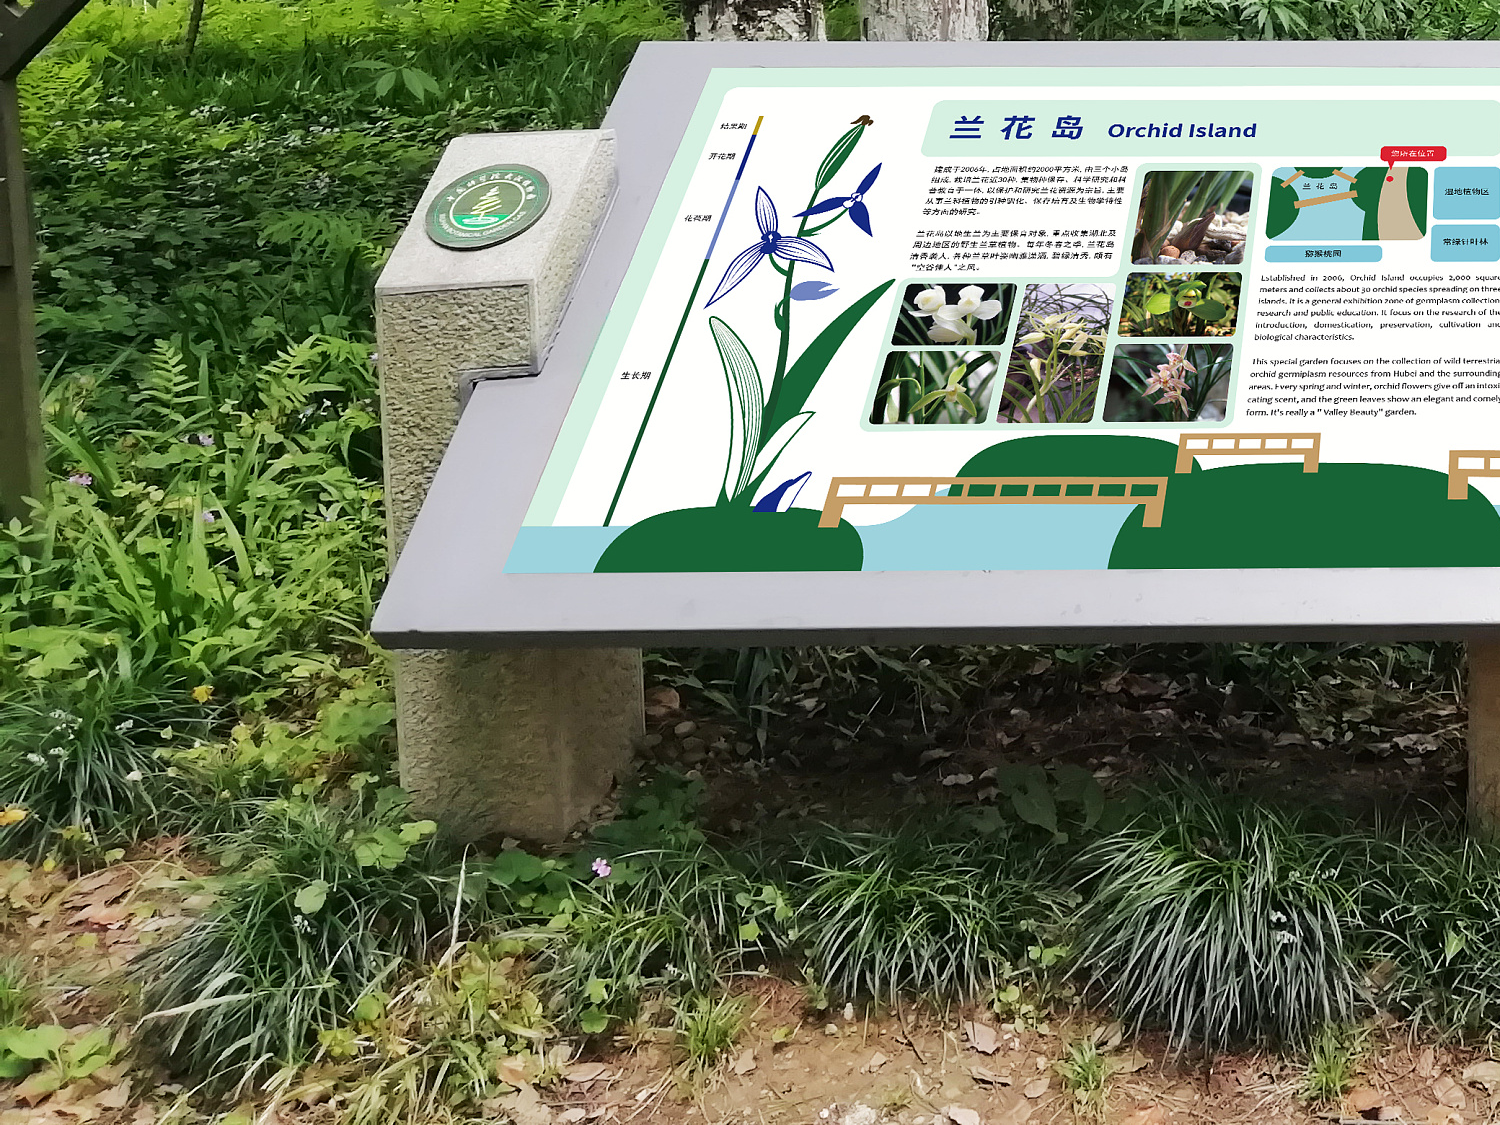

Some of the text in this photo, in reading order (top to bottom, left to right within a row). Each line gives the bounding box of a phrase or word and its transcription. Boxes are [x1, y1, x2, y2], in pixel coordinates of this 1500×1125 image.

[949, 114, 1084, 141] 兰花岛
[1107, 122, 1257, 138] Orchid Island
[708, 152, 737, 161] 开花期
[1390, 149, 1436, 158] 您所在位置
[1302, 181, 1338, 190] 兰花岛
[1444, 187, 1490, 196] 湿地植物区
[1442, 237, 1489, 246] 常绿针叶林
[1304, 249, 1342, 258] 猕猴桃园
[1260, 274, 1306, 282] Established
[1310, 274, 1318, 282] in
[1322, 274, 1345, 282] 2006,
[1349, 274, 1377, 282] Orchid
[1381, 273, 1405, 282] Island
[1409, 275, 1444, 283] occupies
[1448, 274, 1471, 282] 2,000
[1361, 287, 1371, 295] 30
[1372, 285, 1398, 293] orchid
[1398, 285, 1428, 294] species
[1428, 285, 1468, 294] spreading
[1258, 297, 1288, 305] islands.
[1311, 297, 1342, 307] general
[1415, 297, 1461, 306] germplasm
[1256, 309, 1292, 317] research
[1292, 309, 1309, 317] and
[1310, 308, 1335, 318] public
[1336, 308, 1379, 317] education.
[1389, 308, 1412, 316] focus
[1426, 308, 1440, 316] the
[1441, 308, 1477, 316] research
[1477, 308, 1488, 316] of
[1255, 321, 1308, 330] introduction,
[1313, 321, 1374, 330] domestication,
[1379, 321, 1433, 330] preservation,
[1438, 320, 1481, 329] cultivation
[1254, 333, 1355, 342] biological characteristics.
[1252, 357, 1268, 365] This
[1269, 357, 1298, 367] special
[1299, 357, 1329, 367] garden
[1330, 357, 1362, 365] focuses
[1376, 357, 1390, 365] the
[1391, 357, 1431, 365] collection
[1432, 357, 1442, 365] of
[1443, 357, 1461, 365] wild
[620, 370, 652, 380] 生长期
[1249, 370, 1277, 378] orchid
[1370, 369, 1391, 378] from
[1393, 369, 1417, 378] Hubei
[1418, 369, 1435, 378] and
[1436, 369, 1451, 378] the
[1274, 383, 1298, 392] Every
[1298, 382, 1326, 392] spring
[1342, 382, 1373, 391] winter,
[1373, 382, 1401, 390] orchid
[1401, 382, 1433, 390] flowers
[1433, 382, 1451, 392] give
[1451, 381, 1464, 390] off
[1246, 396, 1274, 405] cating
[1274, 396, 1300, 404] scent,
[1300, 395, 1317, 403] and
[1318, 395, 1333, 403] the
[1333, 396, 1358, 405] green
[1359, 395, 1386, 403] leaves
[1386, 395, 1410, 403] show
[1422, 394, 1454, 405] elegant
[1455, 394, 1472, 402] and
[1245, 408, 1269, 417] form.
[1270, 408, 1284, 417] It's
[1285, 408, 1309, 418] really
[1323, 408, 1349, 418] Valley
[1349, 408, 1384, 418] Beauty"
[1384, 407, 1417, 418] garden.
